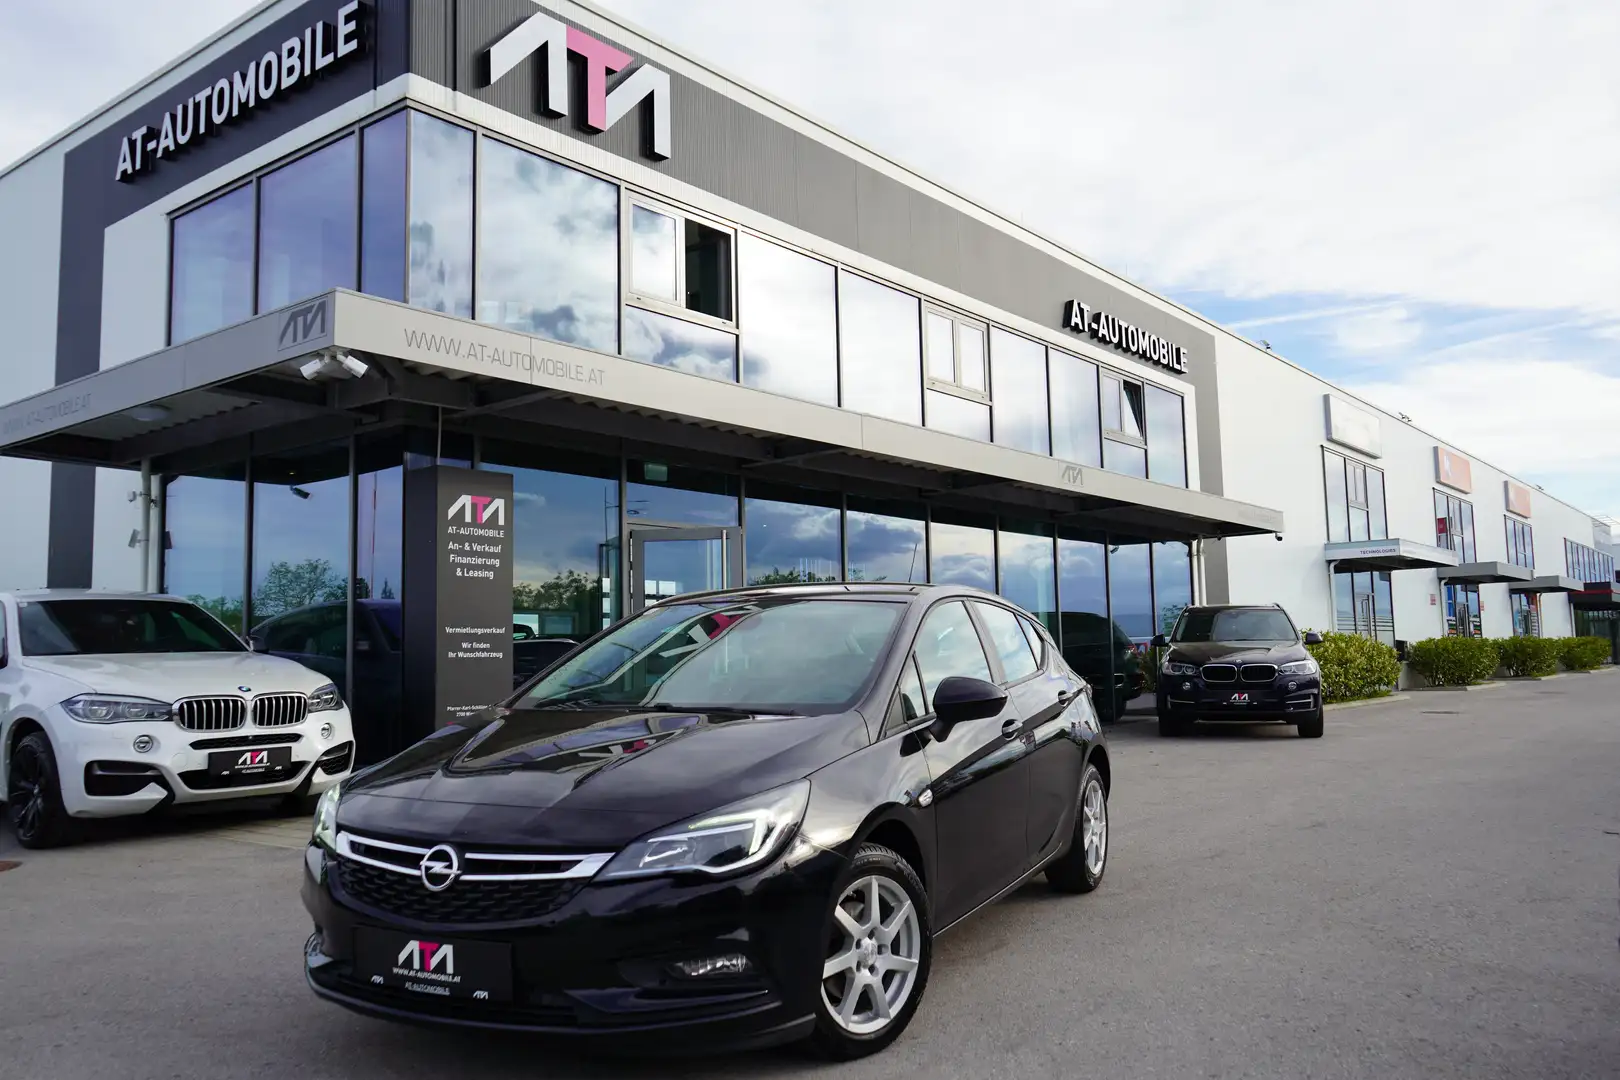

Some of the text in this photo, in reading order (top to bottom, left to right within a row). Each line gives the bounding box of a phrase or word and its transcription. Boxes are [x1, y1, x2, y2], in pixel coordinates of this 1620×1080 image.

[115, 1, 359, 181] AT-AUTOMOBILE
[486, 11, 671, 160] ATA
[1067, 299, 1189, 374] AT-AUTOMOBILE
[404, 328, 606, 386] WWW.AT-AUTOMOBILE.AT
[447, 494, 505, 526] ATA
[447, 526, 505, 538] AT-AUTOMOBILE
[447, 541, 502, 553] An- & Verkauf
[449, 554, 500, 567] Finanzierung
[456, 567, 494, 580] & Leasing
[473, 641, 491, 649] finden
[457, 651, 503, 659] Wunschfahrzeug
[238, 750, 269, 765] ATA
[398, 939, 454, 975] ATA
